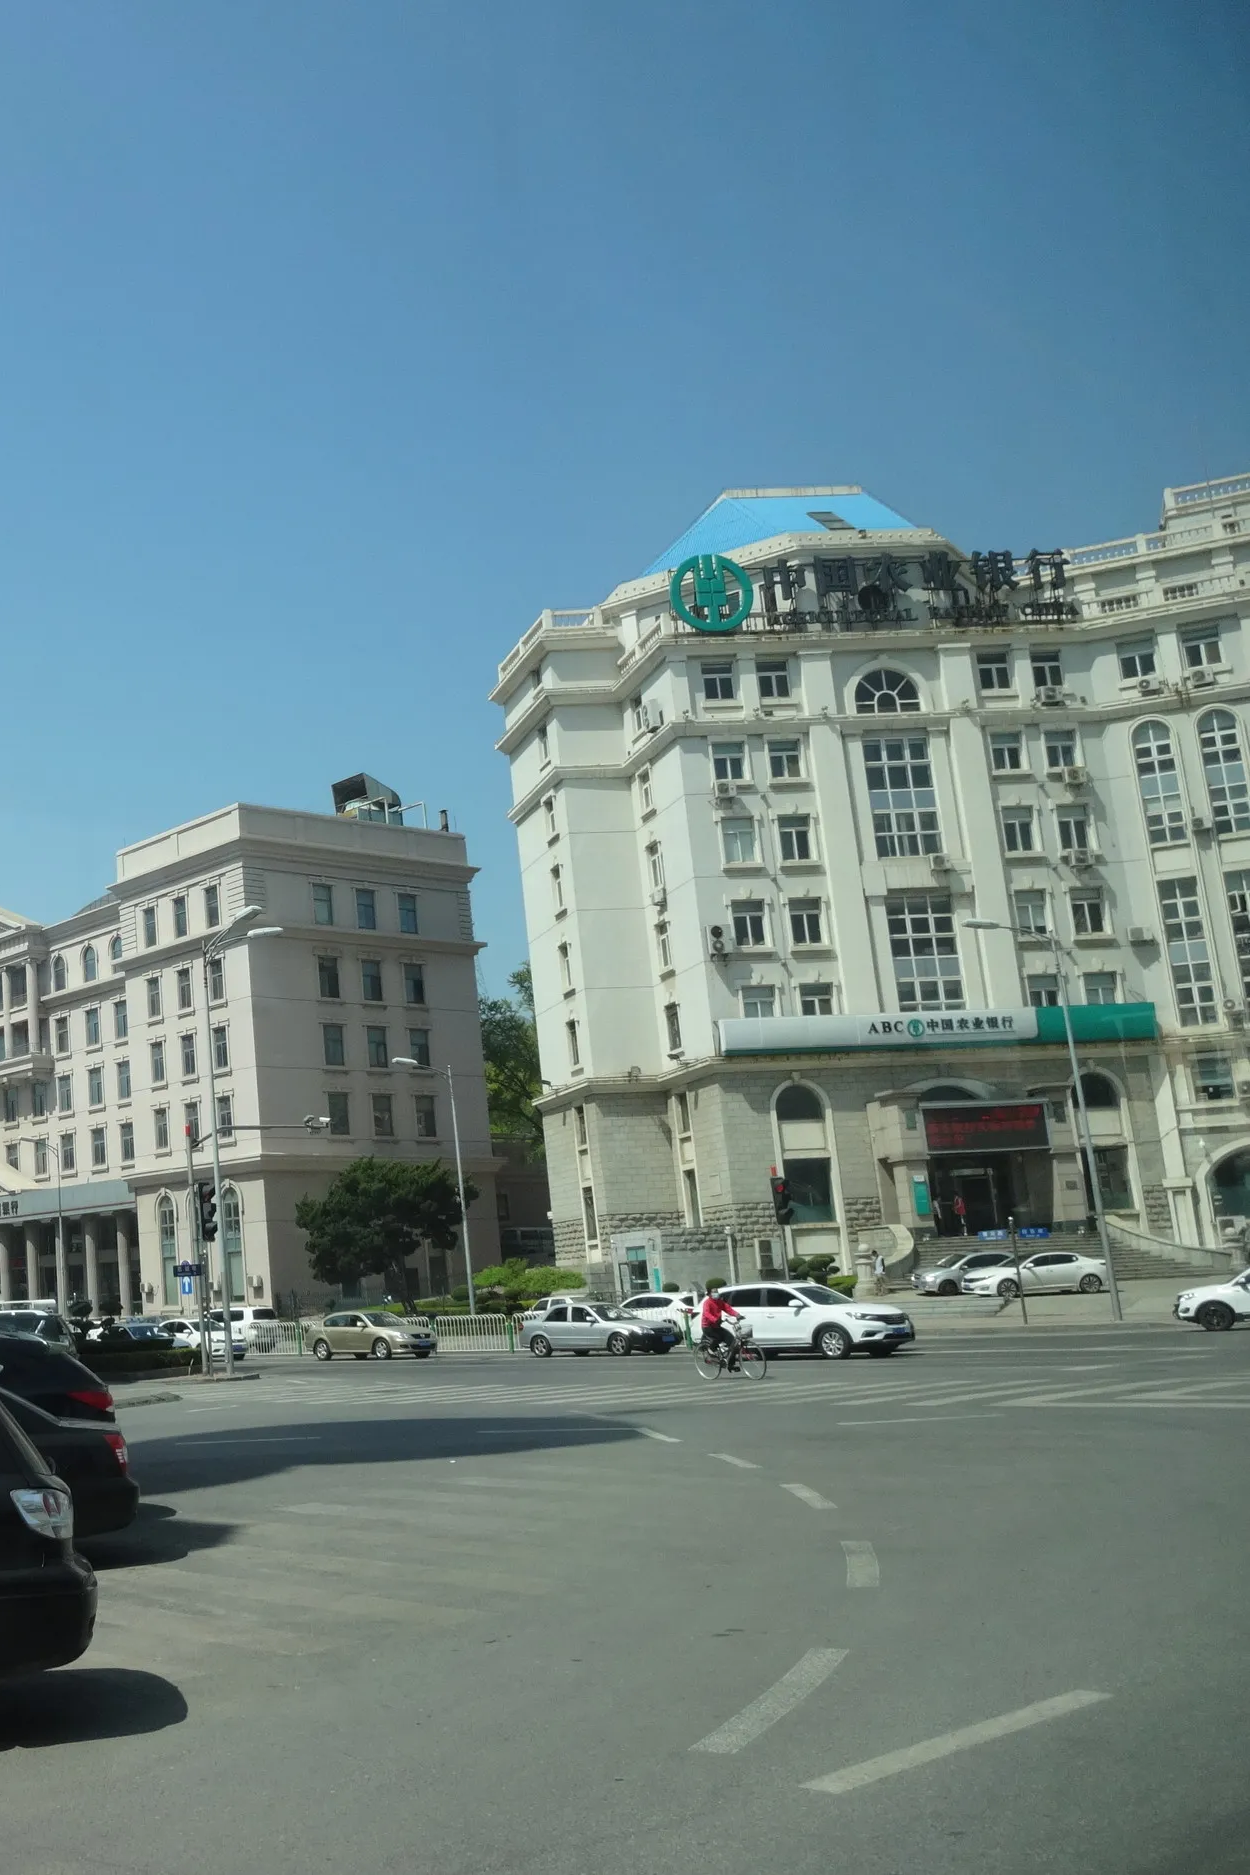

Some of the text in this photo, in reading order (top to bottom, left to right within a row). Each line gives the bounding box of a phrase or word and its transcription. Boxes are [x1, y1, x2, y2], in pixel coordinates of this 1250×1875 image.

[762, 548, 1070, 600] 中国农业银行
[868, 1021, 904, 1034] ABC
[926, 1016, 1014, 1032] 中国农业银行
